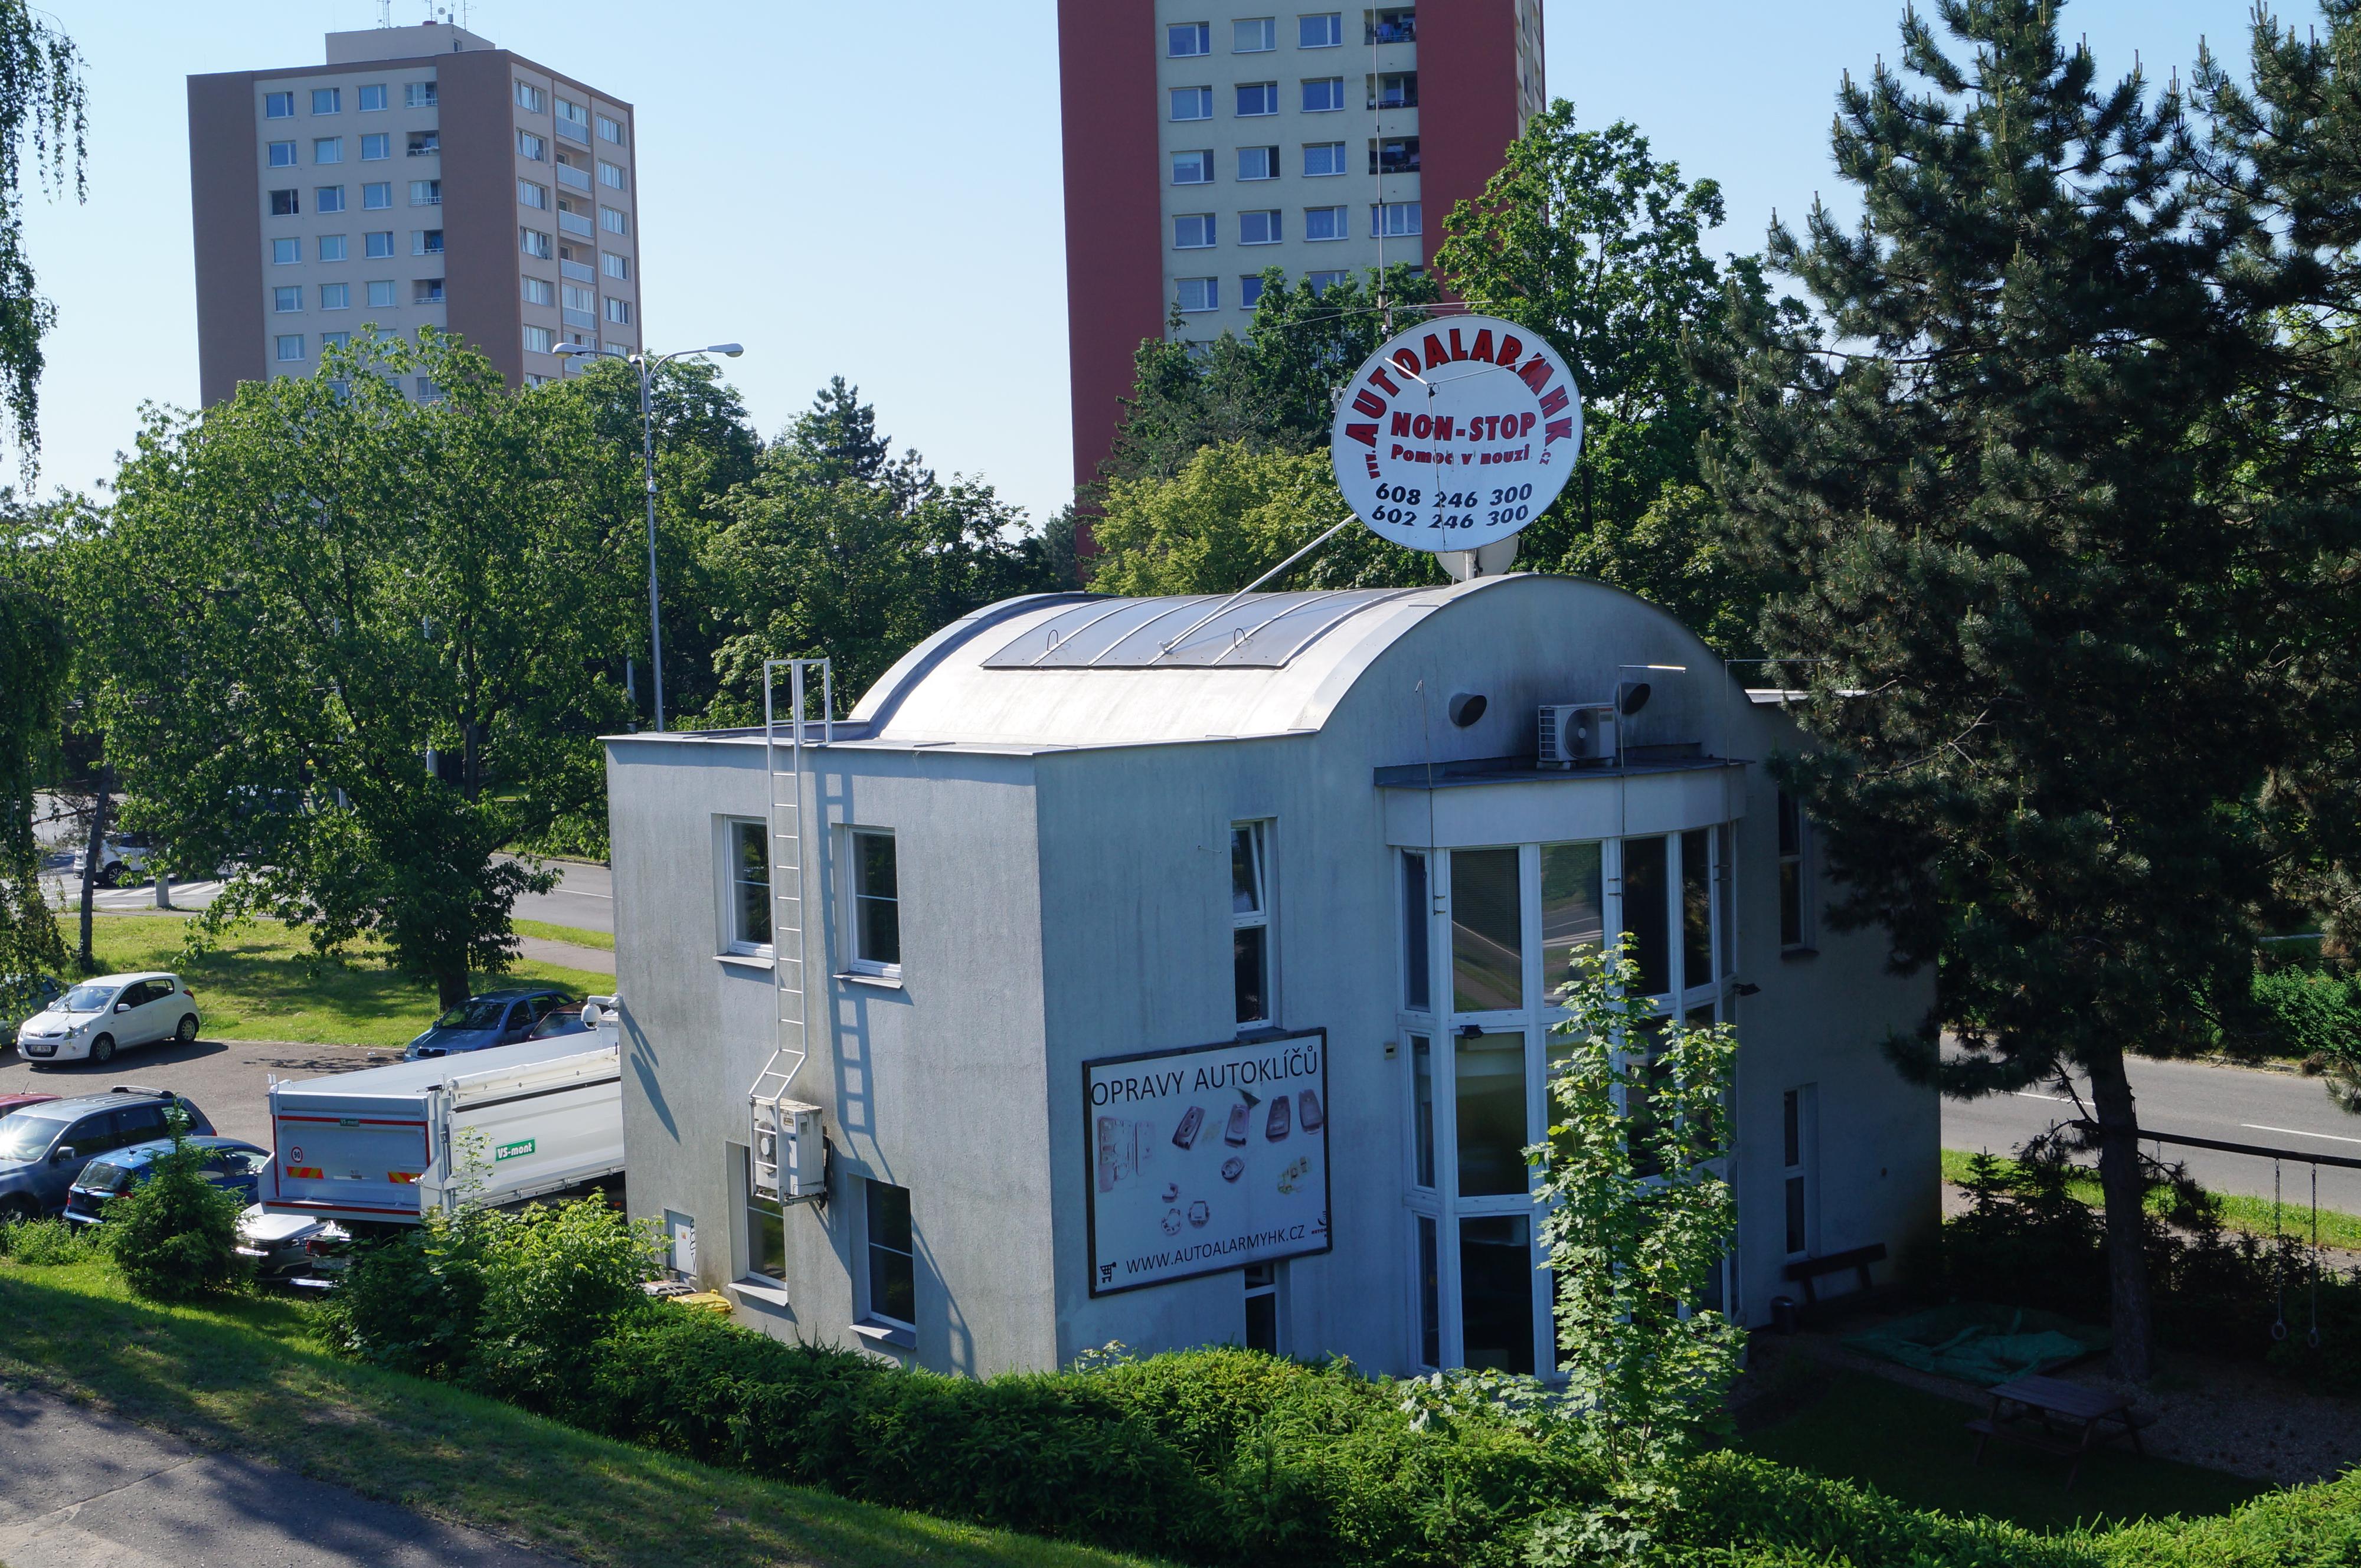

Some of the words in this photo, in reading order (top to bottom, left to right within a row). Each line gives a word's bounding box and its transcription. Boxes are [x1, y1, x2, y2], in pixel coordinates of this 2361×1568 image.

[1391, 411, 1536, 441] NON-STOP
[1391, 444, 1454, 464] Pomoc
[1462, 454, 1472, 464] v
[1480, 444, 1530, 464] nouzi
[1375, 483, 1421, 505] 608
[1431, 491, 1478, 508] 246
[1489, 483, 1533, 506] 300
[1372, 505, 1417, 526] 602
[1428, 514, 1474, 529] 246
[1486, 505, 1529, 526] 300
[1091, 1071, 1184, 1106] OPRAVY
[1194, 1045, 1317, 1091] AUTOKLÍČŮ
[498, 1143, 532, 1158] VS-mont
[1126, 1225, 1305, 1274] WWW.AUTOALARMYHK.CZ
